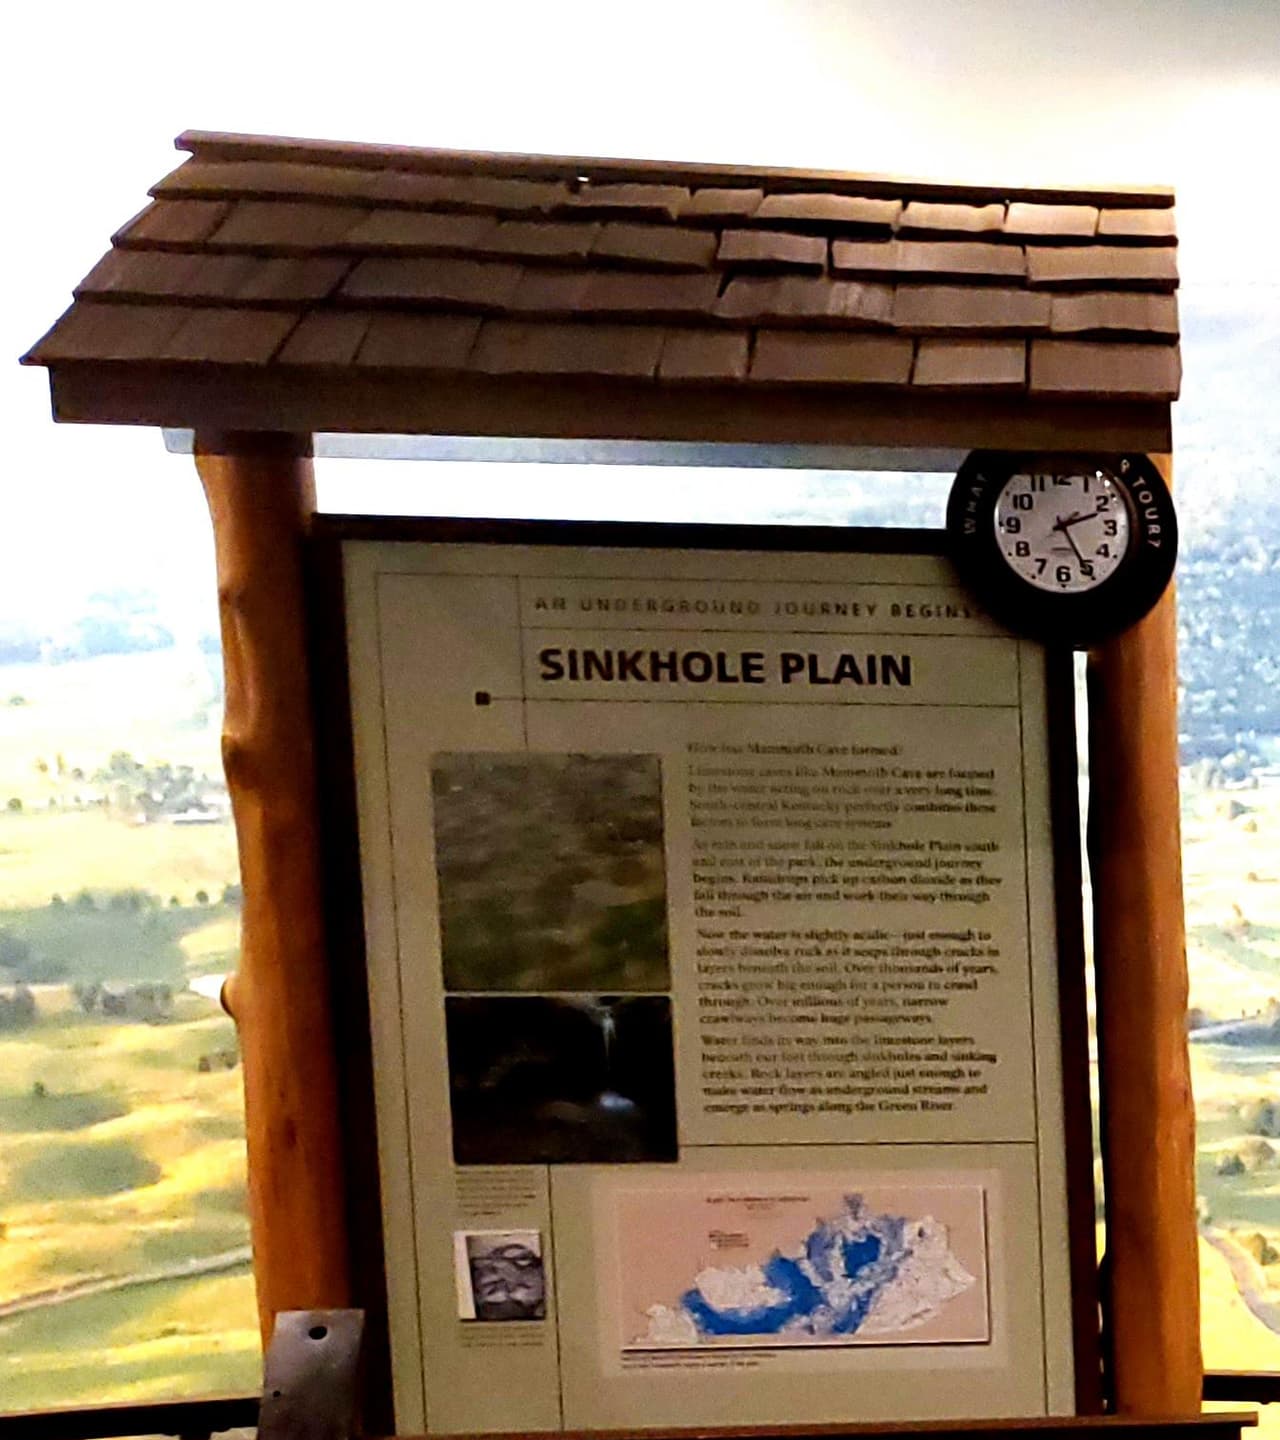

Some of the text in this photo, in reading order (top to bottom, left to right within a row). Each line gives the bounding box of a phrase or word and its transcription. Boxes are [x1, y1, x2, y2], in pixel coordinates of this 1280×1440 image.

[1013, 493, 1033, 510] 10
[1096, 495, 1109, 512] 2
[1132, 478, 1161, 549] TOUR?
[1005, 516, 1021, 533] 9
[1104, 520, 1117, 536] 3
[1015, 541, 1031, 557] 8
[1096, 543, 1110, 558] 4
[1035, 559, 1048, 575] 7
[1056, 565, 1071, 582] 6
[1079, 559, 1094, 576] 5
[580, 598, 760, 615] UNDERGROUND
[775, 600, 877, 617] JOURNEY
[539, 648, 912, 687] SINKHOLE PLAIN
